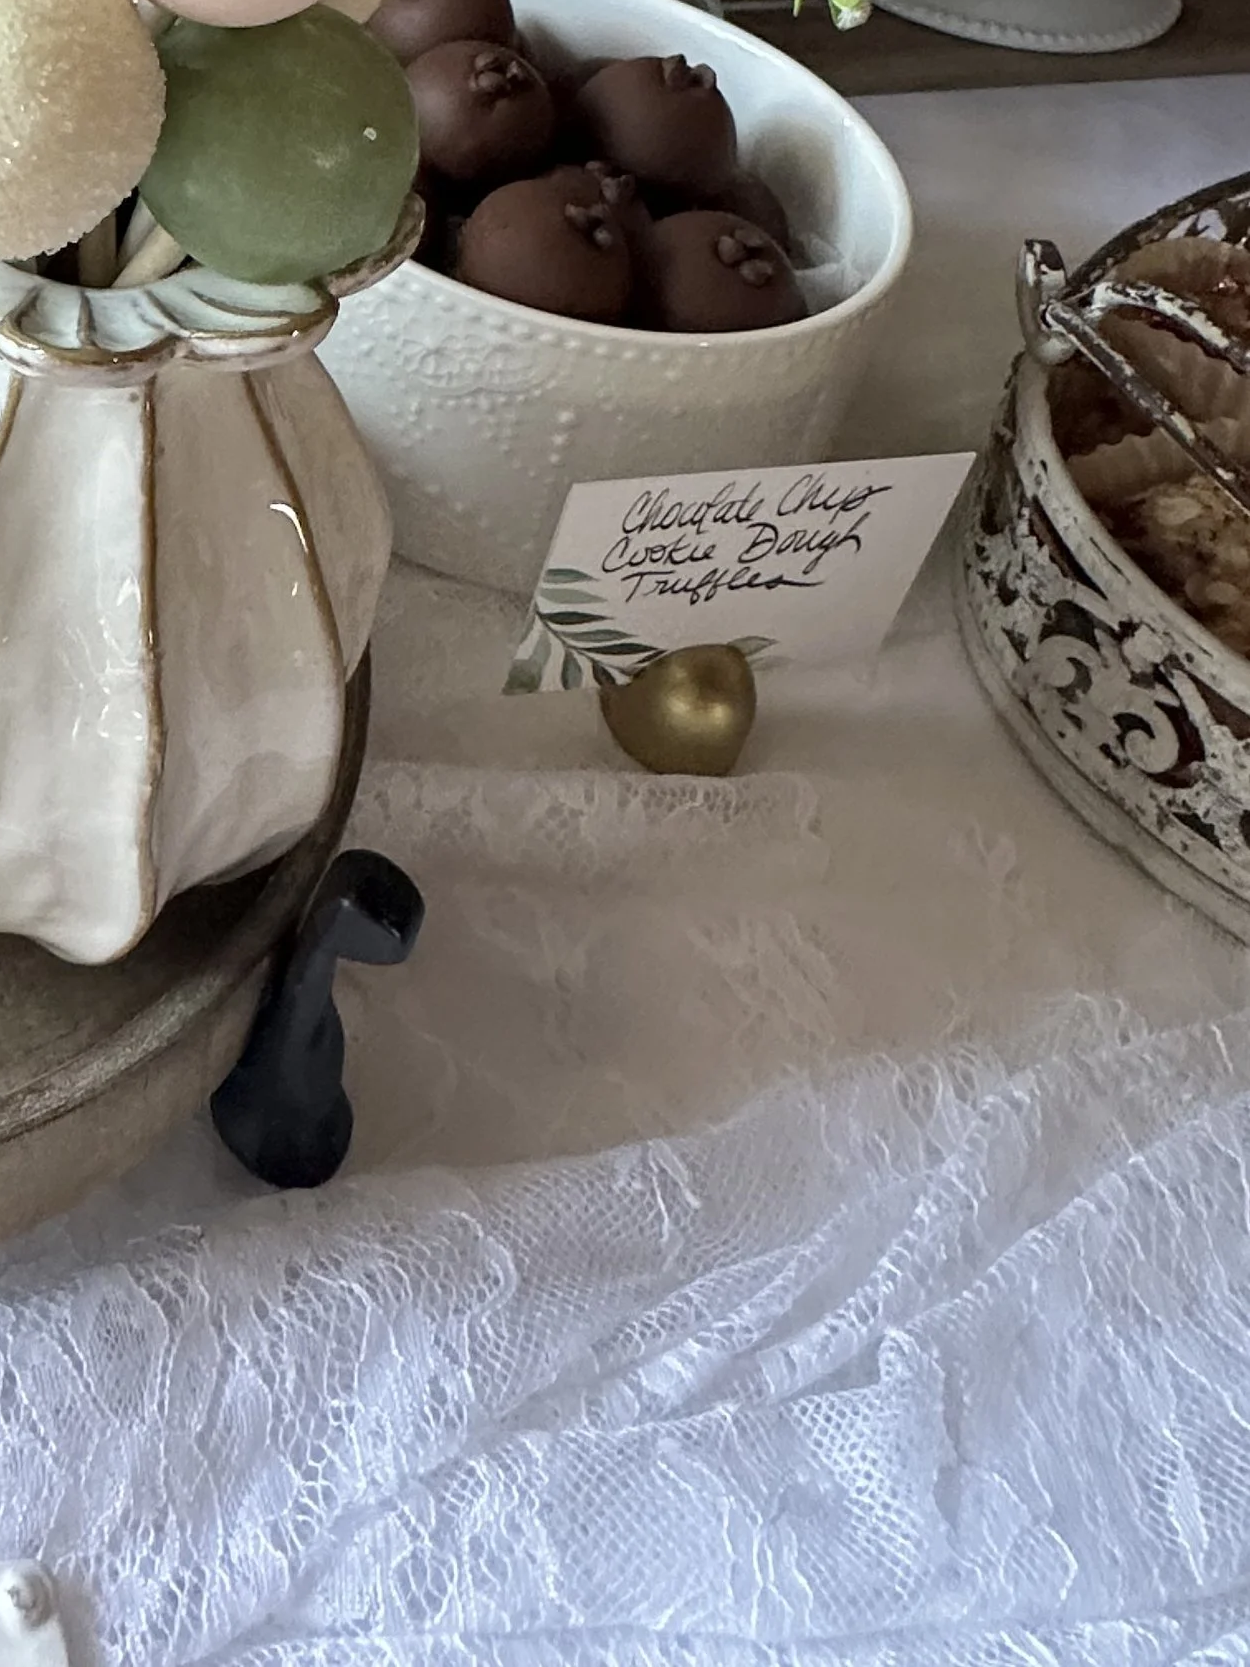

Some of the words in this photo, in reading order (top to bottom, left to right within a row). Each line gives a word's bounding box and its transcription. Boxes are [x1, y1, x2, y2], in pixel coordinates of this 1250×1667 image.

[622, 481, 764, 536] Chocolate
[602, 535, 716, 573] Cookie
[737, 512, 872, 574] Dough
[620, 568, 826, 605] Truffles
